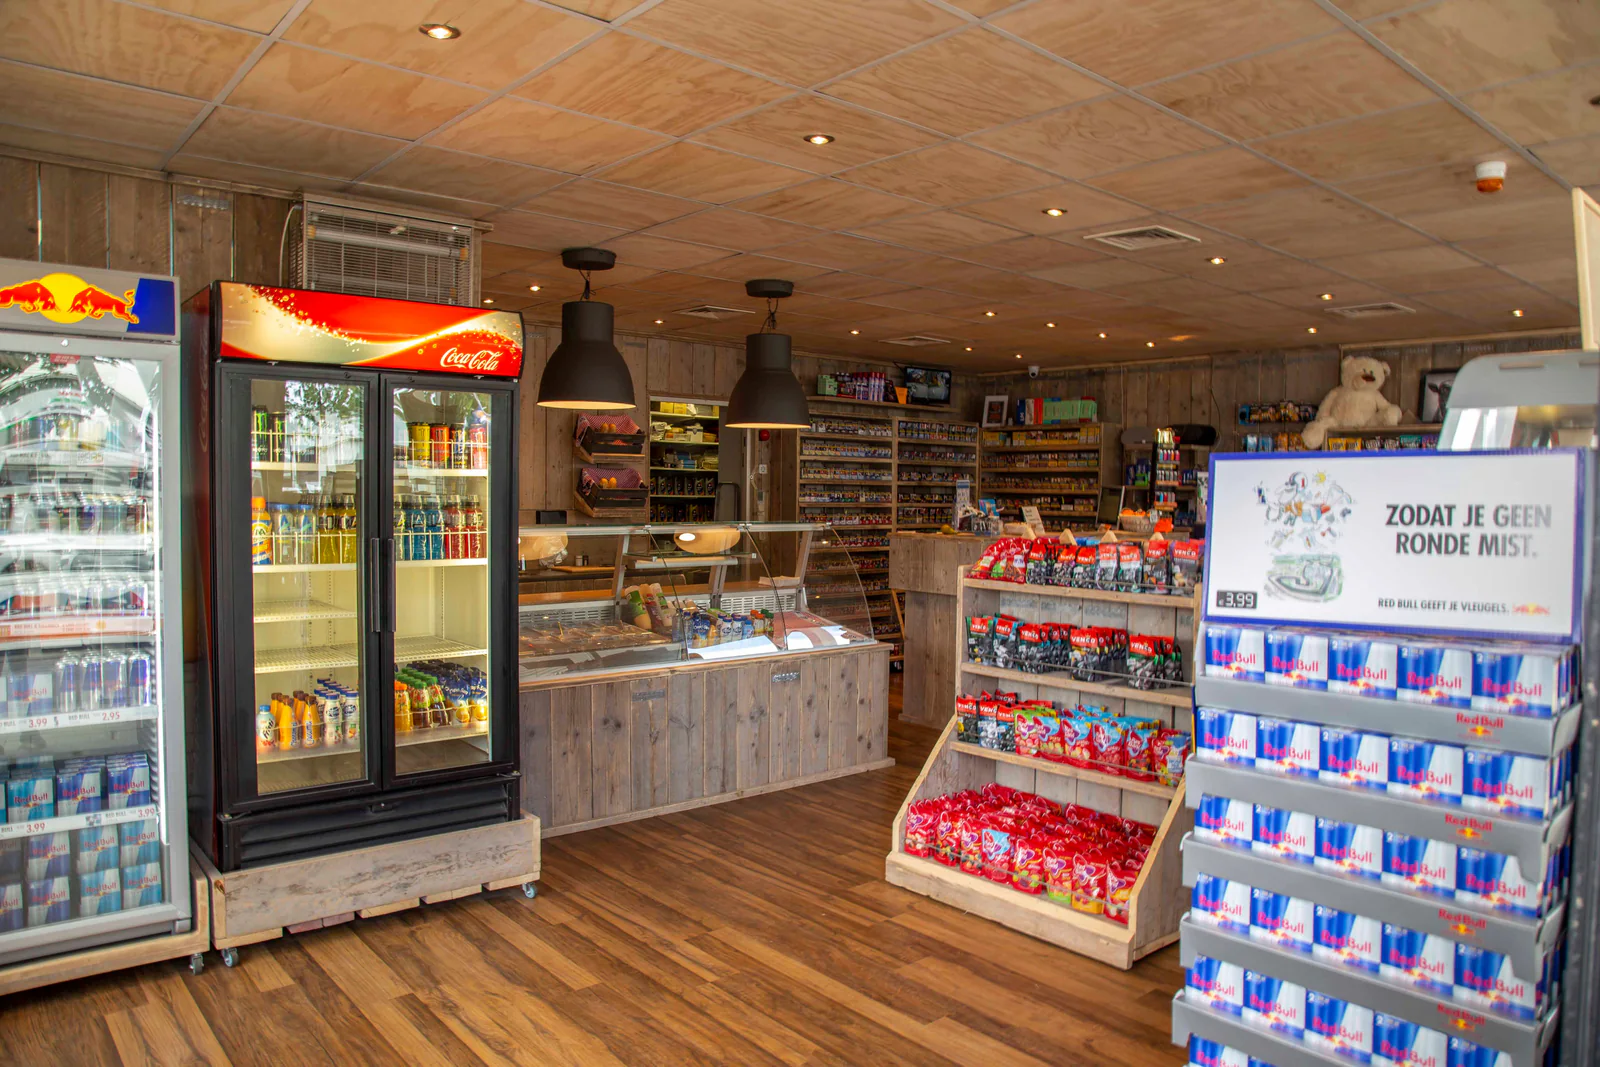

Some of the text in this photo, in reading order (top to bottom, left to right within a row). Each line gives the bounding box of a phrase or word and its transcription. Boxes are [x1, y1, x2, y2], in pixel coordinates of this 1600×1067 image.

[440, 348, 504, 370] Coca-Cola
[1385, 504, 1551, 528] ZODAT JE GEEN
[1396, 532, 1538, 557] RONDE MIST.
[1378, 598, 1395, 608] RED
[1398, 598, 1418, 609] BULL
[1420, 600, 1446, 610] GEEFT
[1448, 601, 1458, 611] JE
[1071, 636, 1095, 644] VENCO
[1131, 642, 1152, 652] VENCO
[1212, 649, 1256, 665] Red Bull
[1272, 656, 1319, 672] Red Bull
[1337, 664, 1387, 680] Red Bull
[1407, 672, 1462, 689] Red Bull
[1482, 678, 1542, 696] Red Bull
[28, 718, 48, 728] 3.99
[102, 712, 120, 721] 2.95
[1456, 712, 1504, 728] Red Bull
[1204, 732, 1248, 750] Red Bull
[1264, 743, 1311, 761] Red Bull
[1327, 755, 1378, 774] Red Bull
[129, 780, 144, 789] Bull
[1397, 765, 1452, 786] Red Bull
[32, 793, 48, 802] Bull
[80, 786, 95, 794] Bull
[1472, 778, 1533, 799] Red Bull
[138, 808, 155, 817] 3.99
[27, 823, 45, 833] 3.99
[1201, 812, 1244, 832] Red Bull
[1445, 813, 1492, 831] Red Bull
[141, 832, 155, 840] Bull
[1259, 827, 1306, 847] Red Bull
[1322, 842, 1372, 863] Red Bull
[1391, 857, 1446, 879] Red Bull
[143, 875, 158, 883] Bull
[1465, 874, 1526, 898] Red Bull
[1198, 894, 1242, 915] Red Bull
[1257, 911, 1304, 934] Red Bull
[1438, 908, 1486, 929] Red Bull
[1321, 930, 1371, 953] Red Bull
[1389, 948, 1445, 974] Red Bull
[1192, 974, 1234, 996] Red Bull
[1463, 970, 1523, 998] Red Bull
[1250, 994, 1296, 1018] Red Bull
[1437, 1003, 1485, 1026] Red Bull
[1313, 1017, 1363, 1042] Red Bull
[1196, 1051, 1218, 1067] Red
[1381, 1040, 1436, 1067] Red Bull
